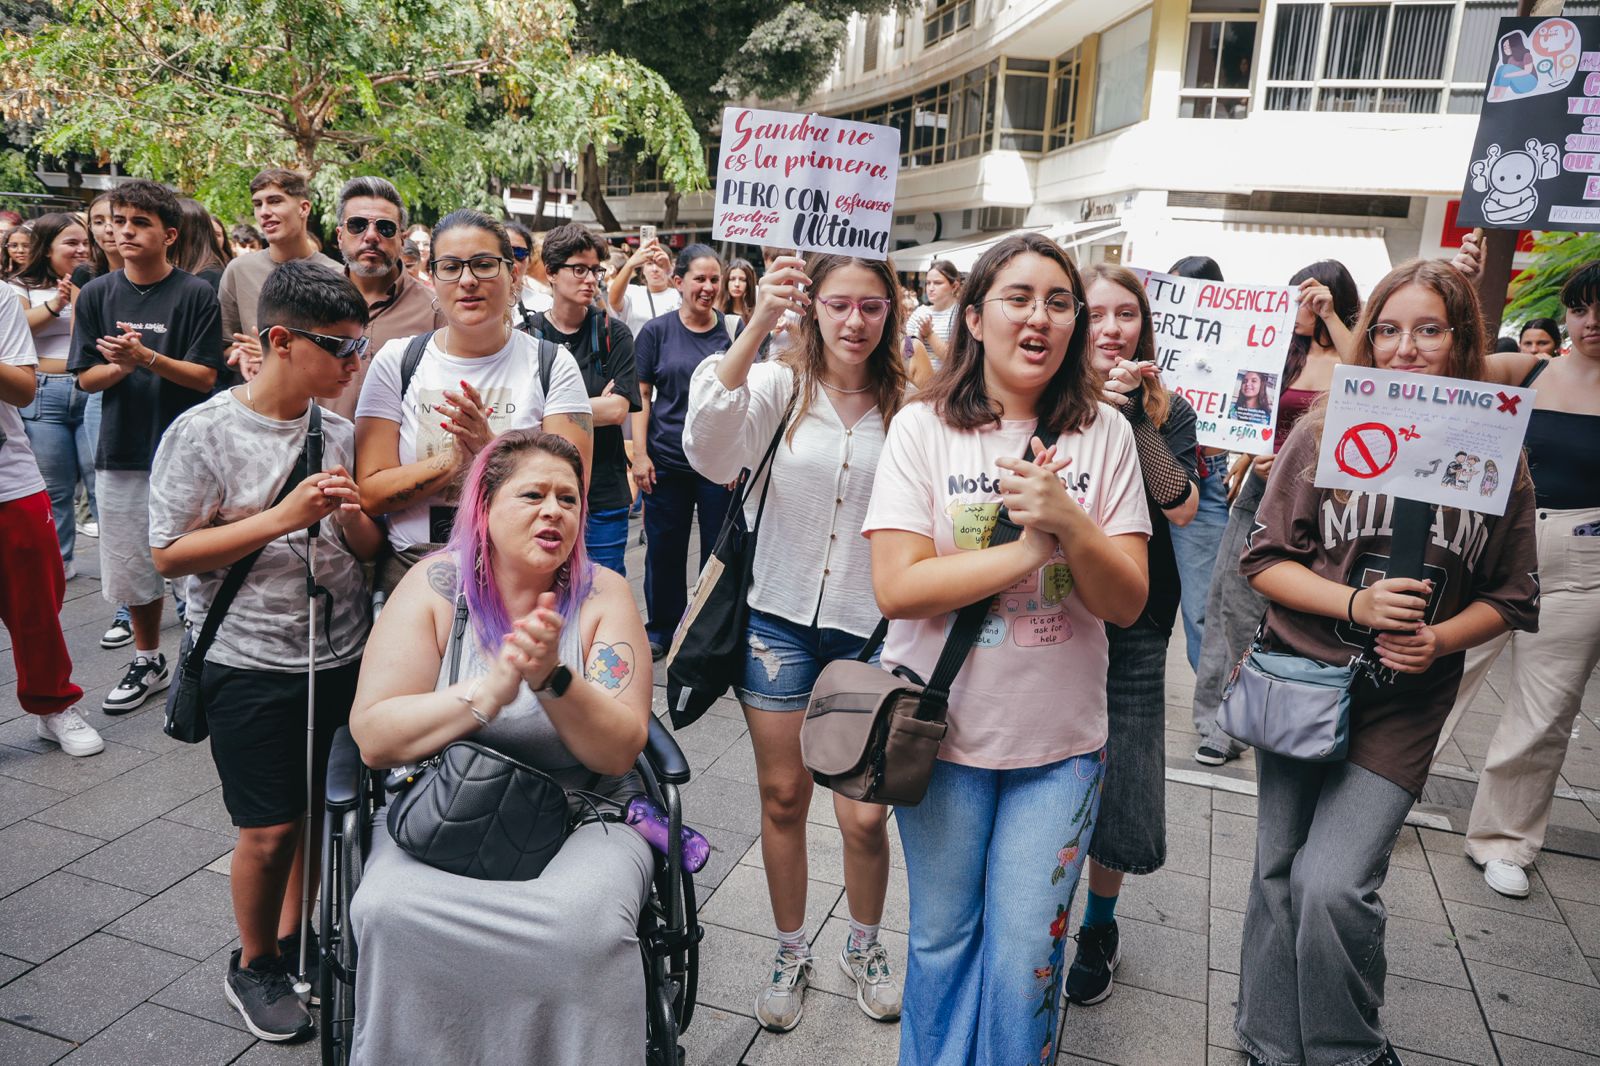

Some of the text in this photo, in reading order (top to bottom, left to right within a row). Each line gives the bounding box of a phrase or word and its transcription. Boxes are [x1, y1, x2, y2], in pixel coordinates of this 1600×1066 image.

[731, 110, 875, 152] Sandra no
[725, 143, 889, 180] es la primera,
[1564, 155, 1594, 169] QUE
[722, 179, 892, 215] PERO CON esfuerzo
[725, 223, 769, 238] ser la
[1197, 284, 1289, 314] AUSENCIA
[1247, 324, 1276, 348] LO
[1156, 347, 1181, 371] UE
[1344, 378, 1494, 409] NO BULLYING
[960, 526, 981, 534] doing
[1030, 616, 1044, 624] it's
[1034, 624, 1062, 634] ask for
[985, 626, 999, 634] and
[1040, 635, 1057, 643] help
